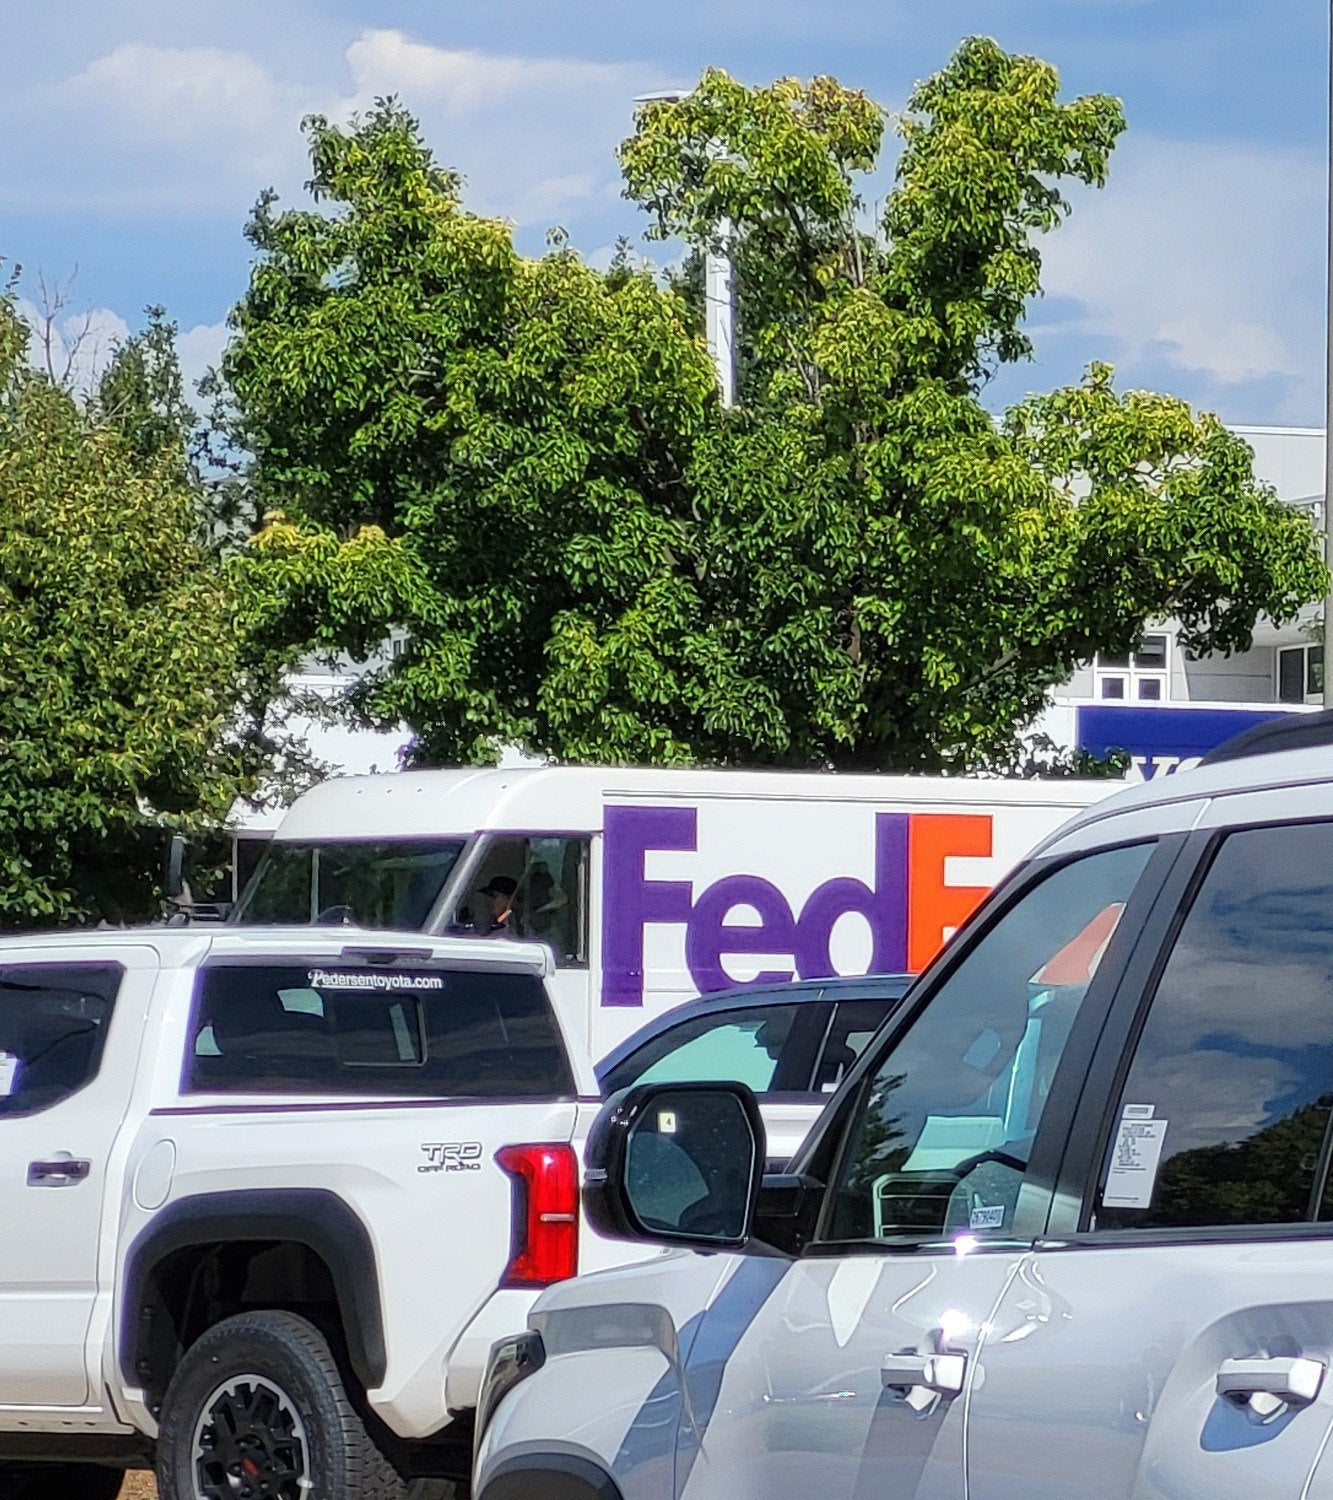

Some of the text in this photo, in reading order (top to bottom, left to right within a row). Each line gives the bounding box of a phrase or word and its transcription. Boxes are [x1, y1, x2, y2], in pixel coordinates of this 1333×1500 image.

[600, 805, 994, 1007] FedE
[307, 969, 443, 991] Pedersentoyota.com
[421, 1142, 482, 1166] TRD
